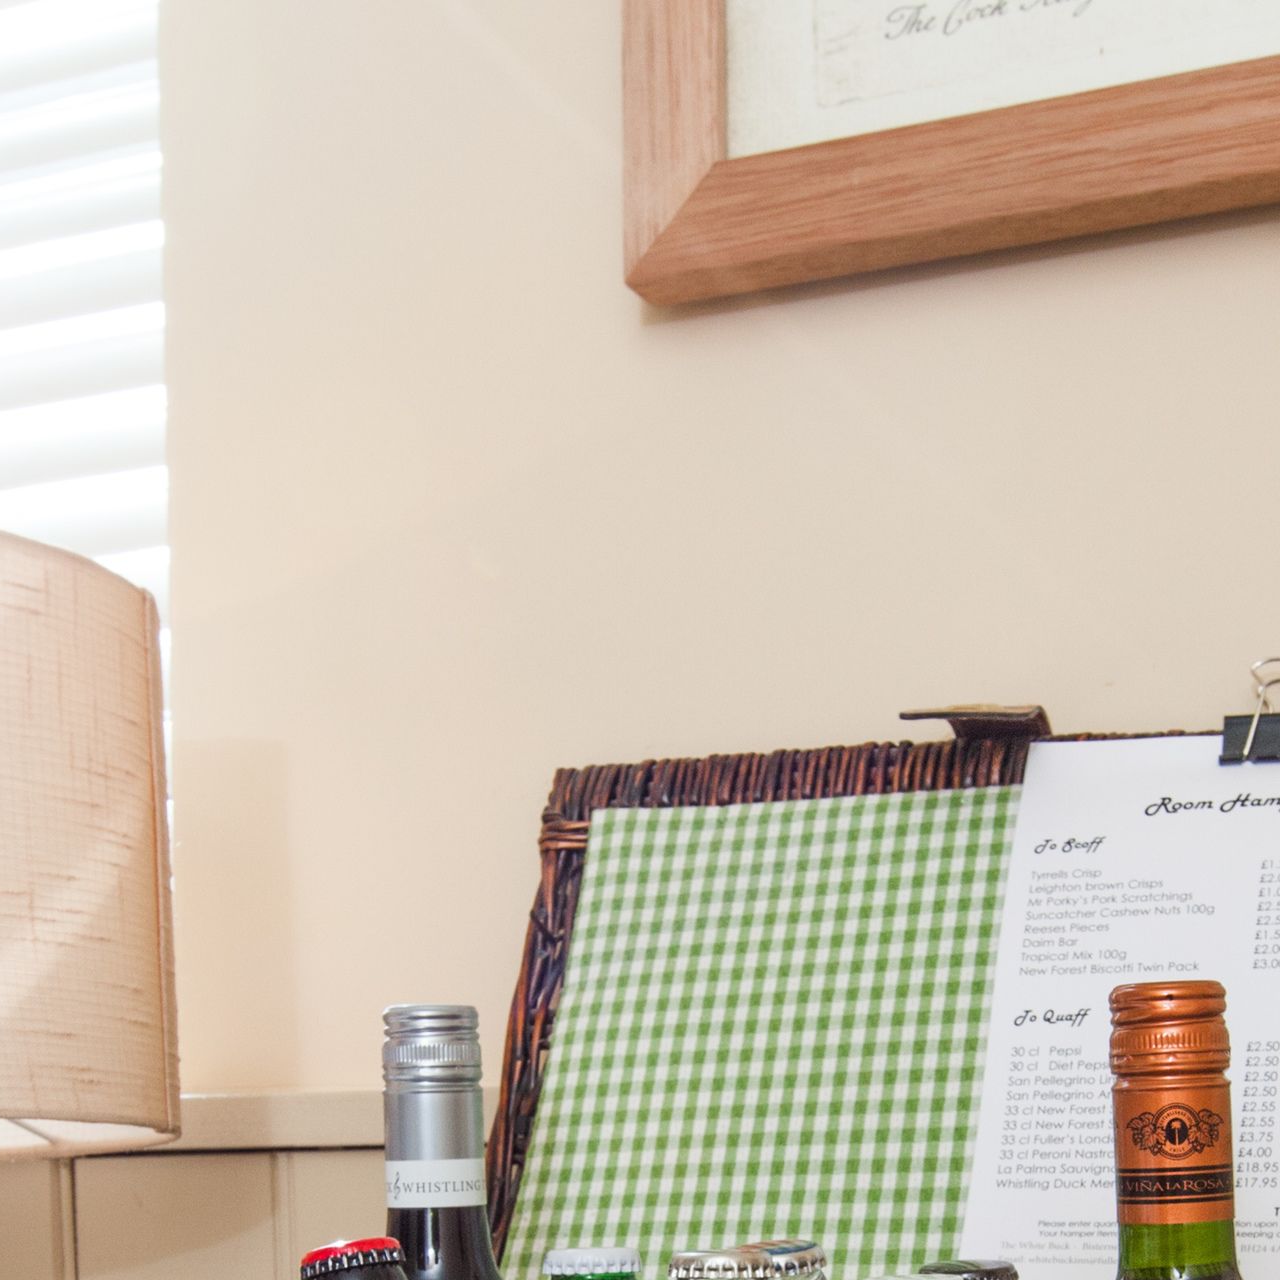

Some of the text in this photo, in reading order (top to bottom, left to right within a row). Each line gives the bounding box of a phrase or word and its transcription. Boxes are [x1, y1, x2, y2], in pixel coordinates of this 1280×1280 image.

[885, 3, 936, 39] The
[1144, 797, 1214, 817] Room
[1033, 839, 1058, 855] To
[1071, 869, 1103, 880] Crisp
[1028, 879, 1164, 896] Leighton brown Crisps
[1027, 898, 1043, 908] Mr
[1091, 894, 1118, 905] Pork
[1121, 891, 1194, 905] Scratchings
[1025, 903, 1216, 922] Suncatcher Cashew Nuts 100g
[1023, 922, 1111, 935] Reeses Pieces
[1022, 936, 1079, 949] Daim Bar
[1020, 948, 1128, 964] Tropical Mix 100g
[1019, 960, 1200, 977] New Forest Biscotti Twin Pack
[1014, 1008, 1092, 1027] To Quaff
[1011, 1046, 1025, 1057] 30
[1048, 1045, 1082, 1058] Pepsi
[1246, 1041, 1280, 1052] £2.50
[1009, 1061, 1024, 1072] 30
[1048, 1060, 1074, 1071] Diet
[1245, 1056, 1280, 1067] £2.50
[1008, 1075, 1096, 1089] San Pellegrino
[1244, 1071, 1279, 1082] £2.50
[1006, 1090, 1028, 1102] San
[1032, 1089, 1095, 1103] Pellegrino
[1243, 1086, 1277, 1097] £2.50
[1004, 1105, 1020, 1116] 33
[1036, 1104, 1065, 1115] New
[1069, 1103, 1106, 1115] Forest
[1241, 1101, 1276, 1112] £2.55
[1002, 1120, 1018, 1131] 33
[1035, 1119, 1064, 1130] New
[1067, 1118, 1105, 1130] Forest
[1240, 1116, 1275, 1128] £2.55
[1001, 1135, 1016, 1146] 33
[1239, 1132, 1274, 1143] £3.75
[999, 1149, 1014, 1161] 33
[1031, 1148, 1071, 1160] Peroni
[1238, 1146, 1272, 1158] £4.00
[997, 1164, 1013, 1175] La
[1016, 1164, 1056, 1175] Palma
[1236, 1161, 1279, 1173] £18.95
[402, 1180, 481, 1193] WHISTLING
[995, 1178, 1050, 1192] Whistling
[1053, 1178, 1086, 1190] Duck
[1125, 1179, 1225, 1192] VIÑA LA ROSA
[1235, 1176, 1278, 1188] £17.95
